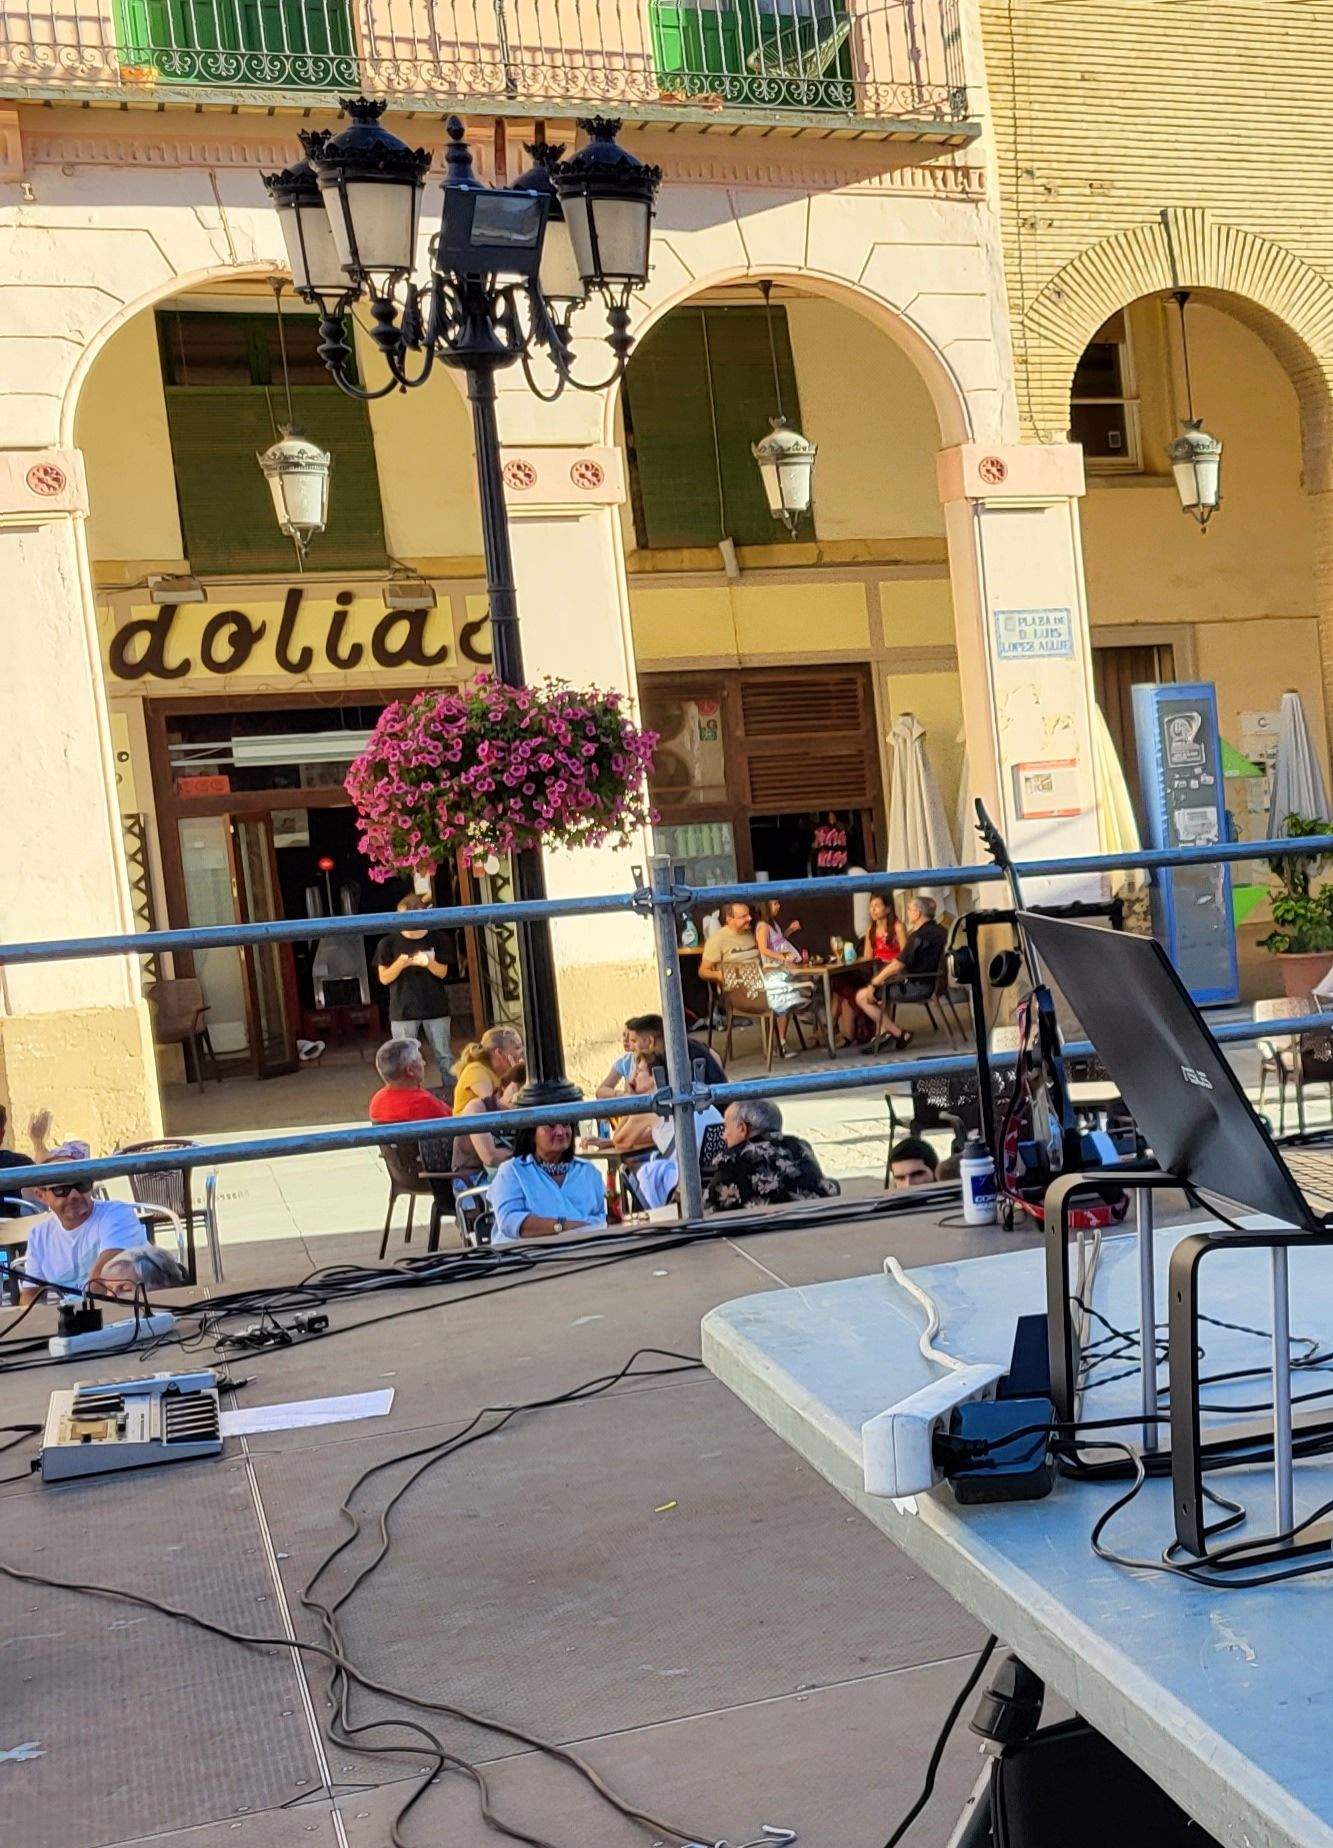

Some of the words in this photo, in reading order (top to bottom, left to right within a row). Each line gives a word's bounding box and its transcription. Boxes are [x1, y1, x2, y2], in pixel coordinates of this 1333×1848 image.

[1018, 614, 1051, 627] PLAZA
[1034, 628, 1062, 639] LUIS
[1180, 1065, 1214, 1090] ASUS
